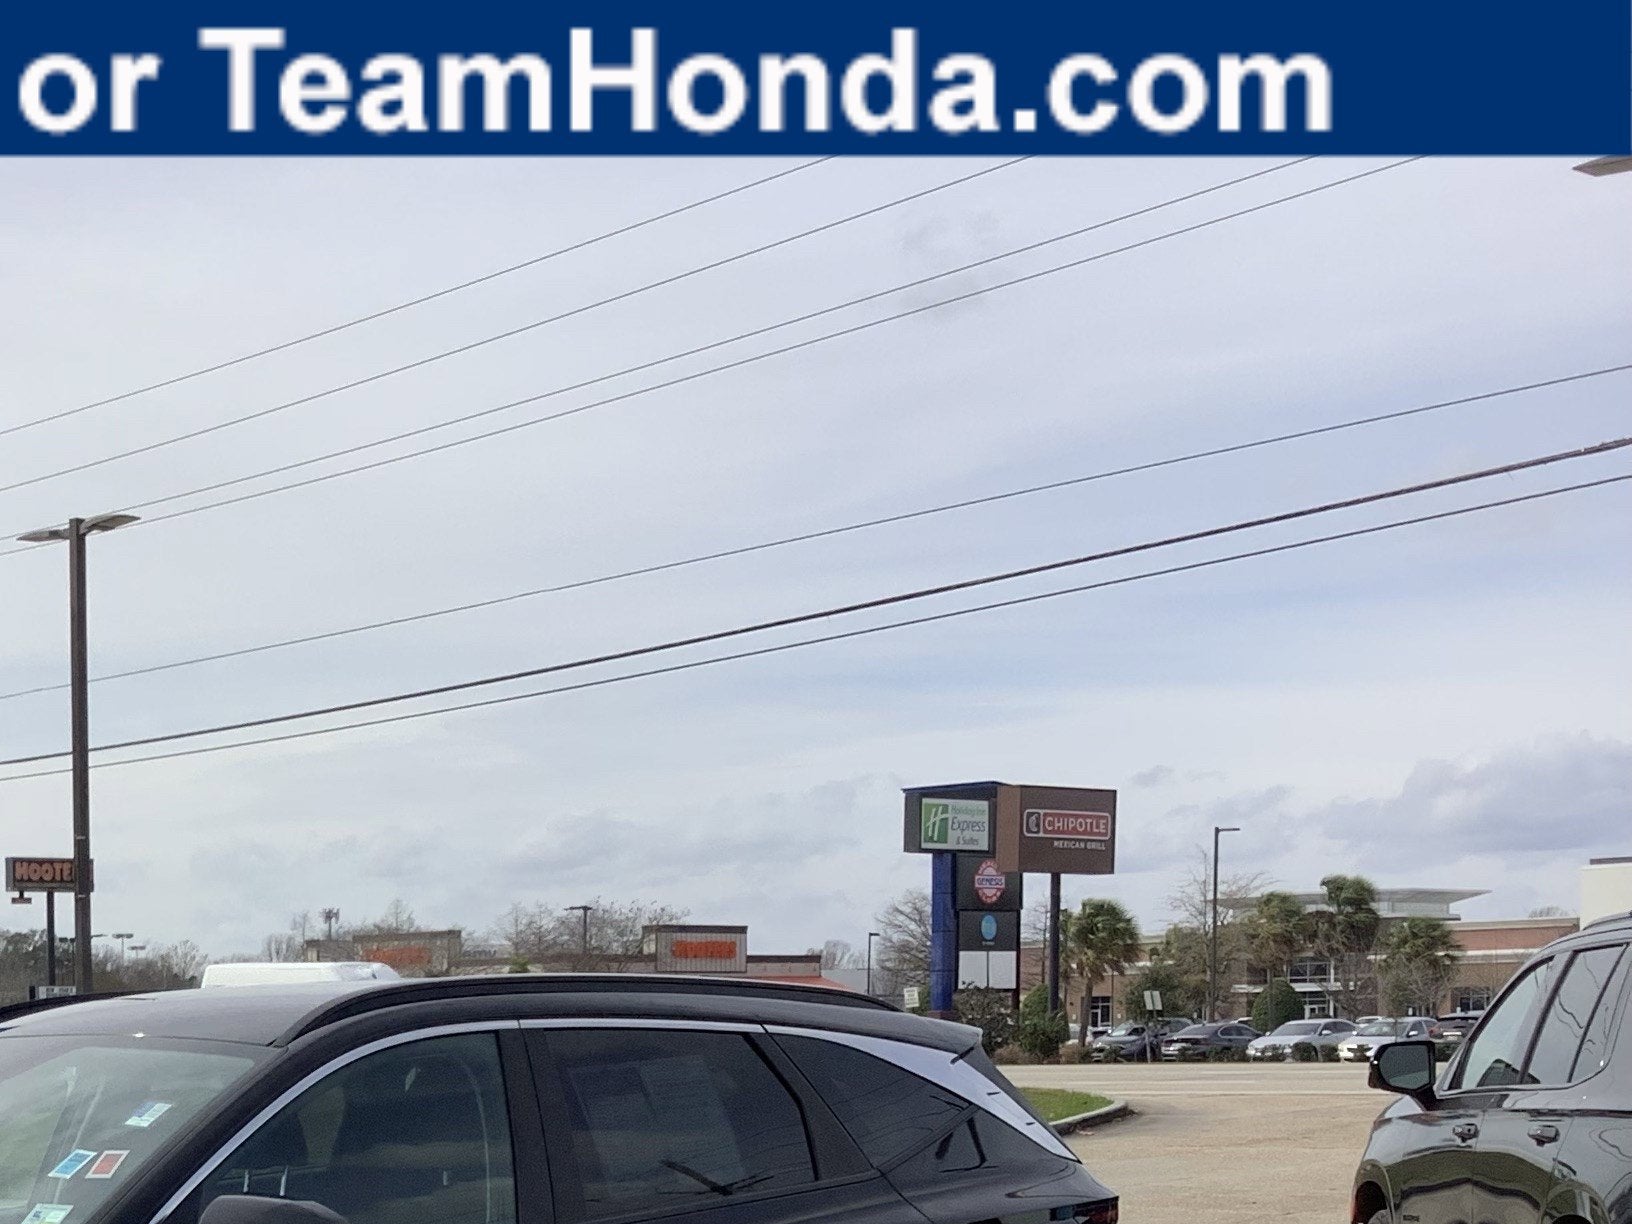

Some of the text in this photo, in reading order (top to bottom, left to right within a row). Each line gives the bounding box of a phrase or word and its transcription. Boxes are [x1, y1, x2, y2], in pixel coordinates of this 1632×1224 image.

[951, 816, 986, 835] Express
[1045, 816, 1106, 833] CHIPOTLE
[961, 837, 979, 846] Suites
[1053, 840, 1106, 851] MEXICAN GRILL
[14, 861, 73, 881] HOOTE
[976, 877, 1003, 886] GENESIS
